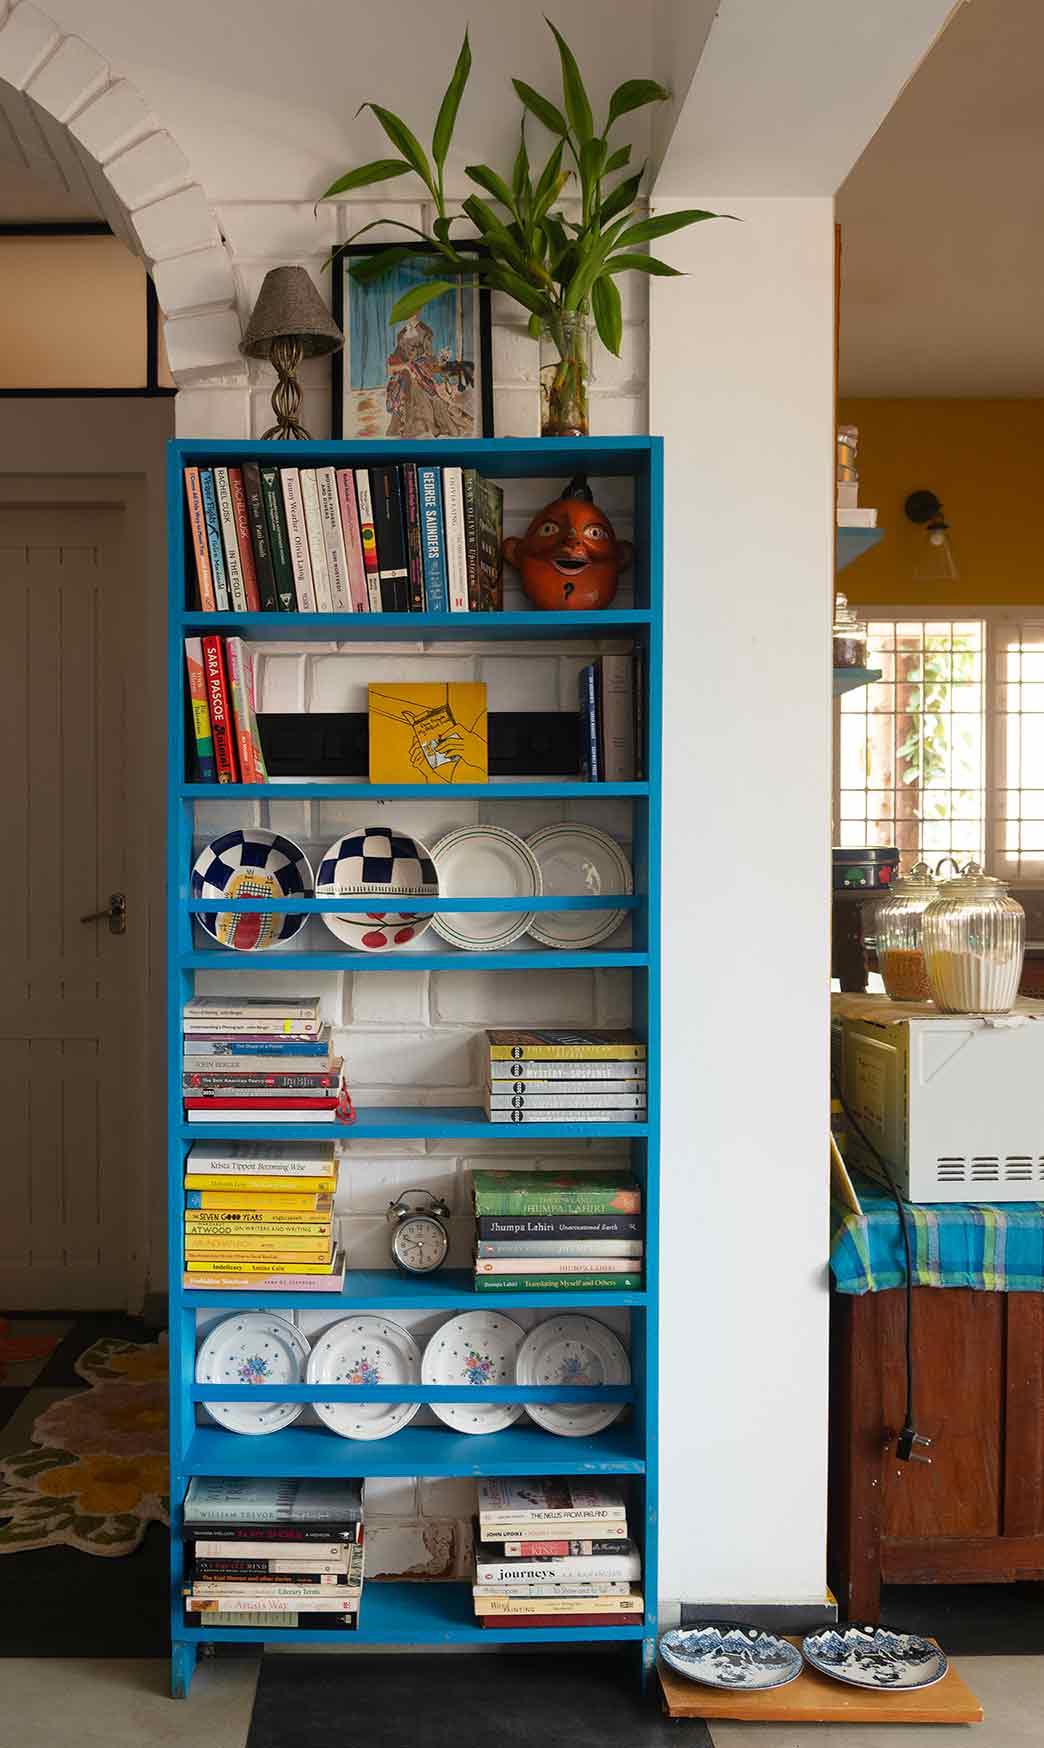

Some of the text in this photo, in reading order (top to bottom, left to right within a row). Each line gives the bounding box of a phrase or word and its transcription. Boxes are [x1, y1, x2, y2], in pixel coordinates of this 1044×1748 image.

[217, 470, 231, 523] RACHEL CUSK
[424, 472, 437, 507] GEORGE
[238, 517, 248, 538] CUSK
[288, 503, 298, 533] Weather
[426, 511, 439, 559] SAUNDERS
[228, 550, 240, 597] IN THE FOLD
[207, 647, 224, 721] SARA PASCOE
[200, 1213, 220, 1221] SEVEN
[490, 1223, 525, 1232] Jhumpa
[498, 1569, 556, 1580] journeys
[269, 1601, 288, 1610] Way
